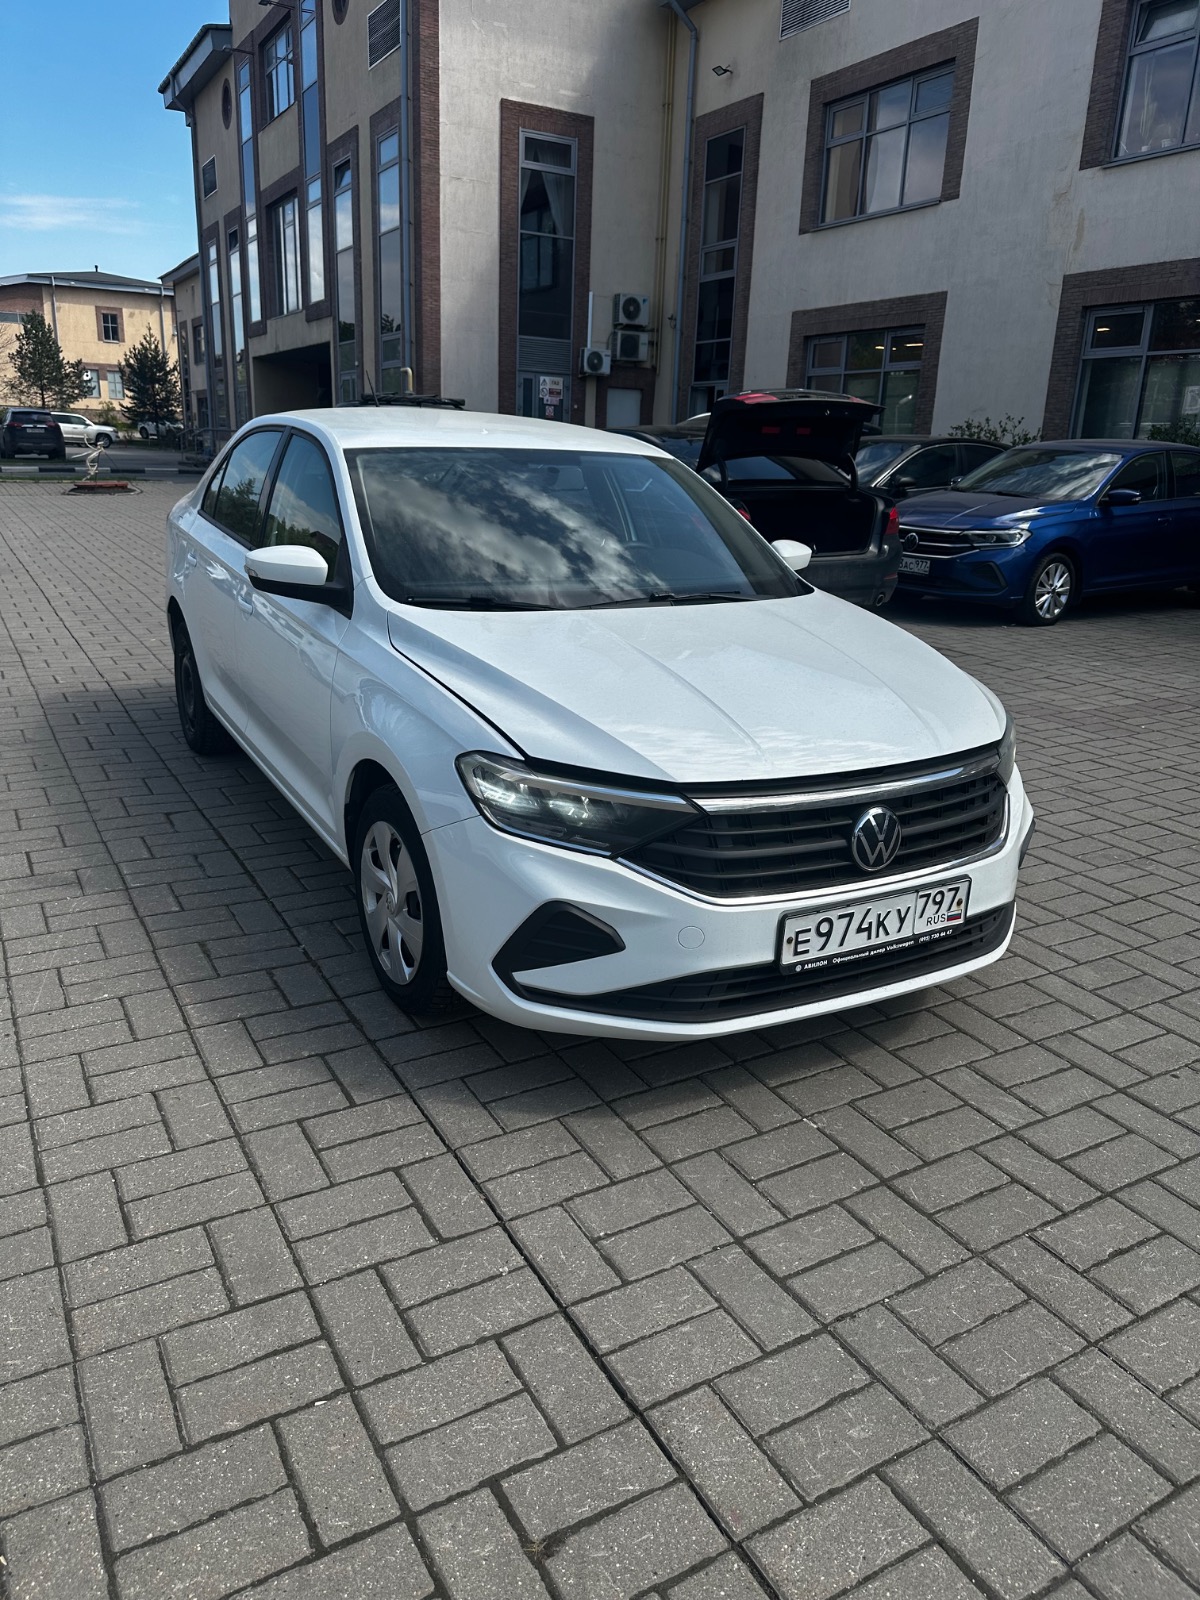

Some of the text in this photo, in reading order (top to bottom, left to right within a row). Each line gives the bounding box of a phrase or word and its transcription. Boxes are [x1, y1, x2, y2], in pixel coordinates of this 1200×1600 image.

[915, 560, 928, 569] 977
[918, 886, 961, 919] 797
[792, 905, 912, 957] Е974КУ
[926, 912, 947, 927] RUS
[803, 959, 828, 970] АВИЛОН
[832, 951, 869, 963] Официальный
[886, 940, 915, 951] Volkswagen
